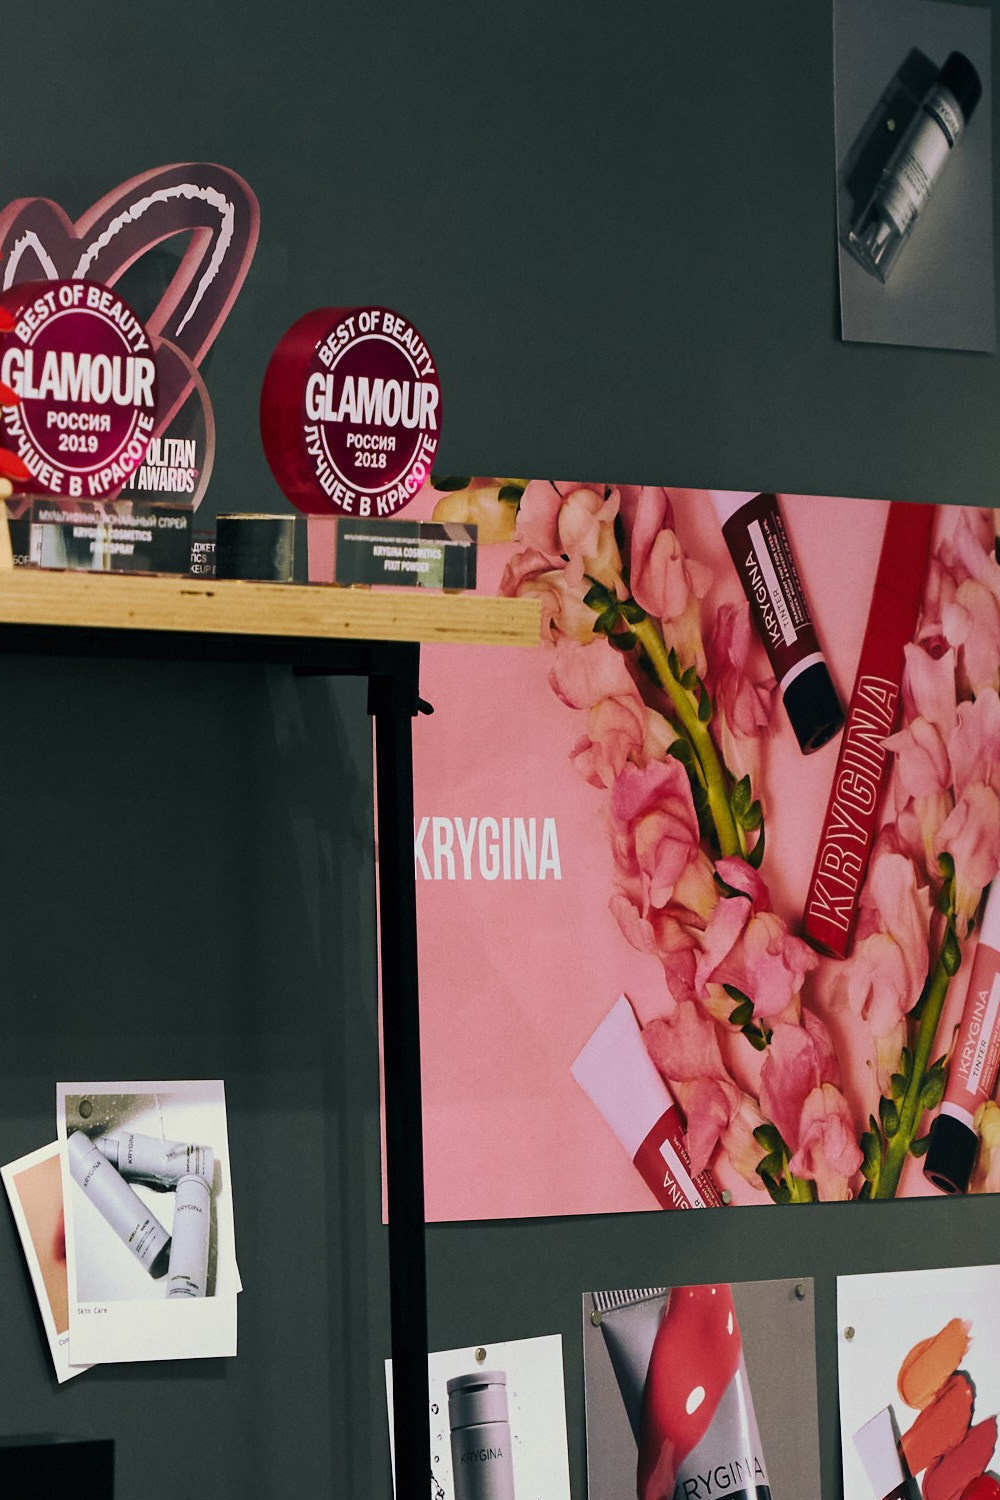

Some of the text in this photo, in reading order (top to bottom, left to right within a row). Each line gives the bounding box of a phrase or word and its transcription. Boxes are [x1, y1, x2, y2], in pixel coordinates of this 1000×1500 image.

[14, 285, 149, 352] BEST OF BEAUTY
[318, 311, 435, 377] BEST OF BEAUTY
[1, 347, 155, 407] GLAMOUR
[305, 372, 439, 430] GLAMOUR
[2, 405, 154, 497] ЛУЧШЕЕ В КРАСОТЕ
[47, 411, 111, 432] РОССИЯ
[346, 433, 396, 451] РОССИЯ
[137, 466, 195, 493] AWARDS
[304, 425, 438, 517] ЛУЧШЕЕ В КРАСОТЕ
[744, 550, 781, 643] KRYGINA
[772, 589, 790, 629] TINTER
[809, 675, 899, 931] KRYGINA
[959, 990, 989, 1073] KRYGINA
[973, 1040, 987, 1076] TINTER
[460, 1447, 503, 1464] KRYGINA
